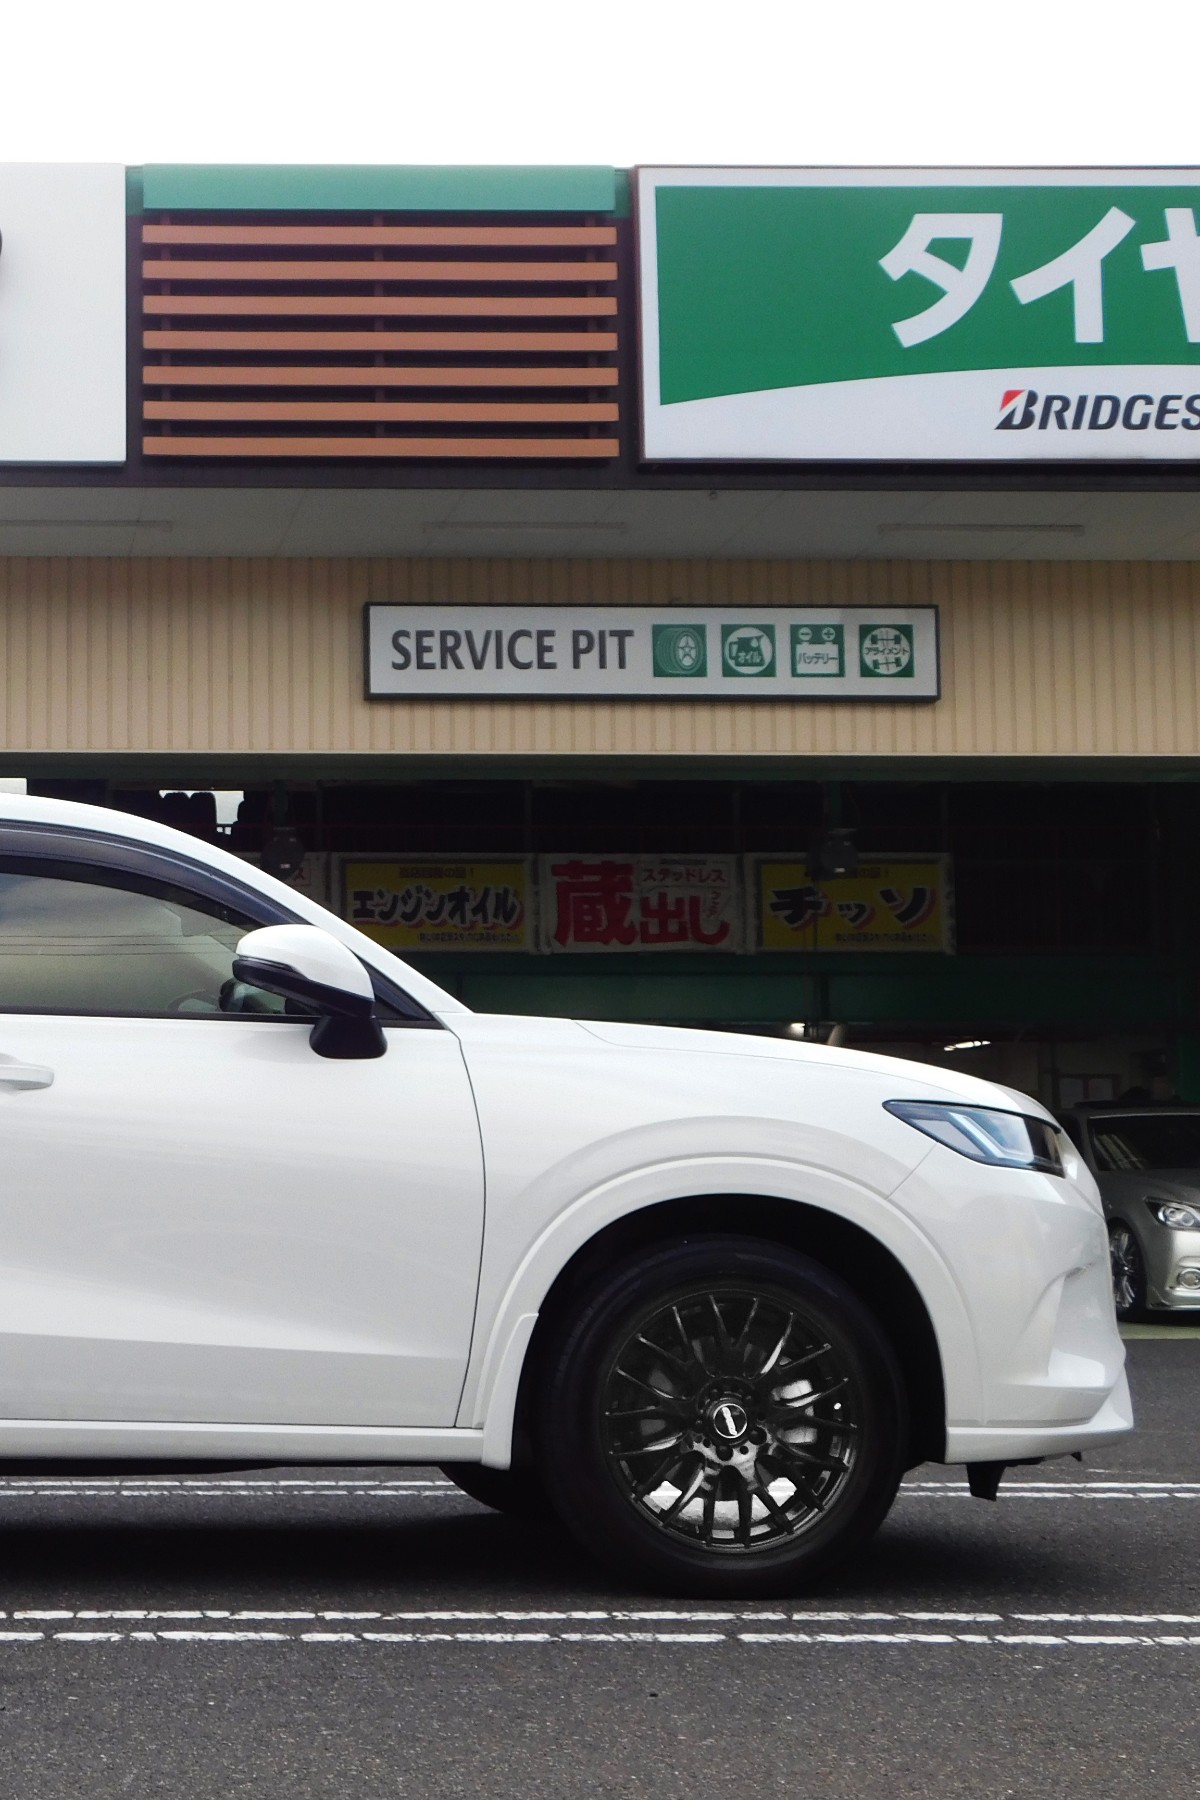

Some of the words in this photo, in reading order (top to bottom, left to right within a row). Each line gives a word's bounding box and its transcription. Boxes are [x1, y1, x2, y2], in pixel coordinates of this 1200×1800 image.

[391, 629, 557, 670] SERVICE
[572, 629, 634, 669] PIT
[737, 651, 761, 664] オイル
[798, 653, 839, 665] バッテリー
[864, 646, 910, 656] アライメント
[642, 867, 727, 883] スタッドレス
[352, 885, 520, 927] エンジンオイル
[551, 860, 731, 945] 蔵出し
[769, 886, 930, 927] チッソ
